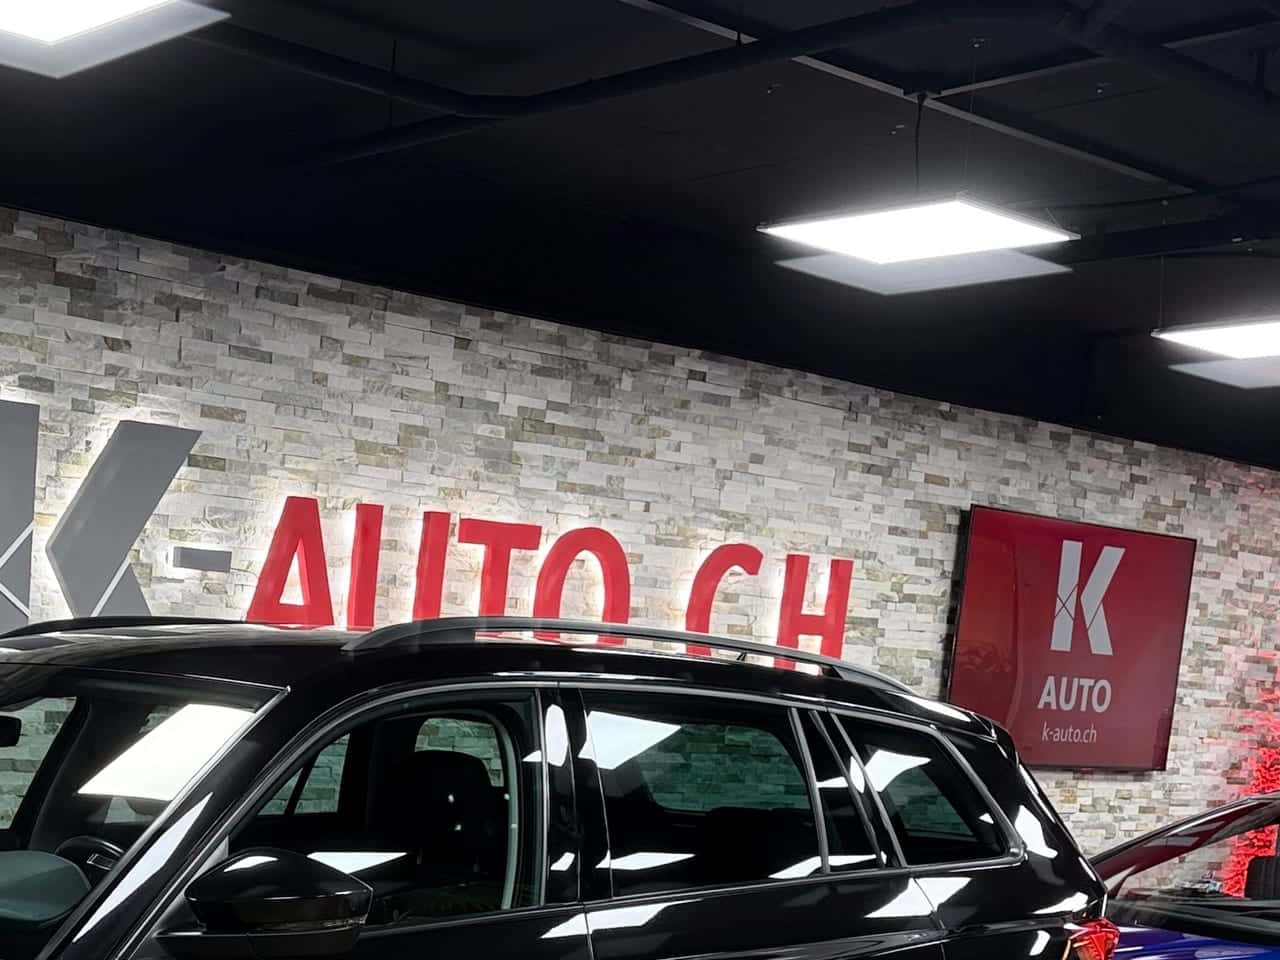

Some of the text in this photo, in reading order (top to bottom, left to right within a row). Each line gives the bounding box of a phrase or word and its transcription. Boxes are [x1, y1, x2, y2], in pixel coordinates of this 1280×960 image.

[1050, 539, 1126, 656] K
[1037, 675, 1112, 713] AUTO
[1041, 722, 1097, 744] k-auto.ch
